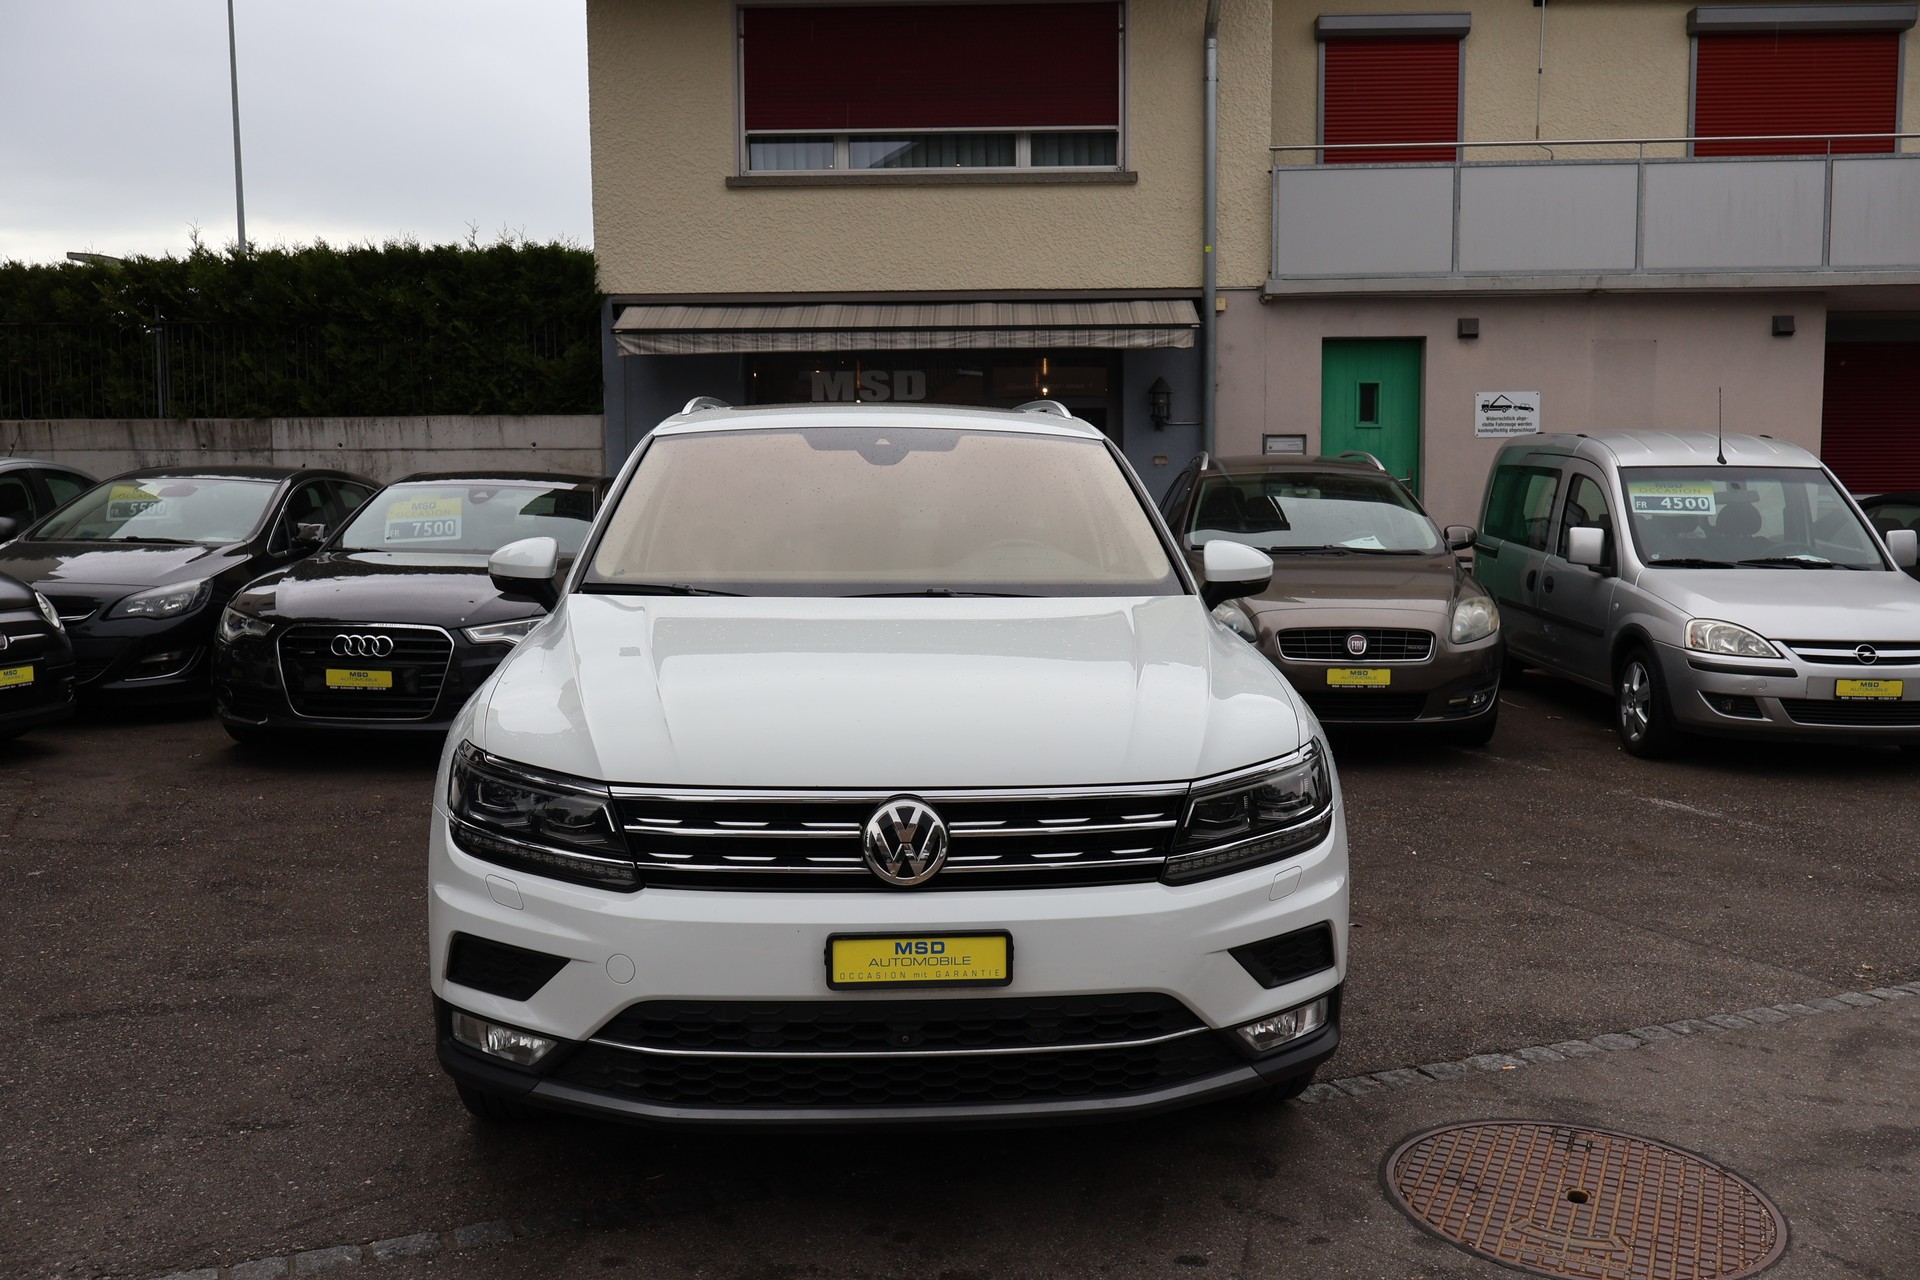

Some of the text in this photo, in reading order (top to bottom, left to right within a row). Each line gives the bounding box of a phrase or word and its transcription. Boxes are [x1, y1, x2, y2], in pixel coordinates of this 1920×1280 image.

[811, 370, 926, 402] MSD
[412, 502, 436, 510] MSD
[1660, 497, 1709, 510] 4500
[396, 508, 451, 518] OCCASION
[390, 520, 454, 538] FR 7500
[1352, 640, 1364, 650] FIAT
[894, 941, 946, 955] MSD
[868, 956, 972, 968] AUTOMOBILE
[840, 971, 906, 980] OCCASION
[936, 968, 1000, 979] GARANTIE
